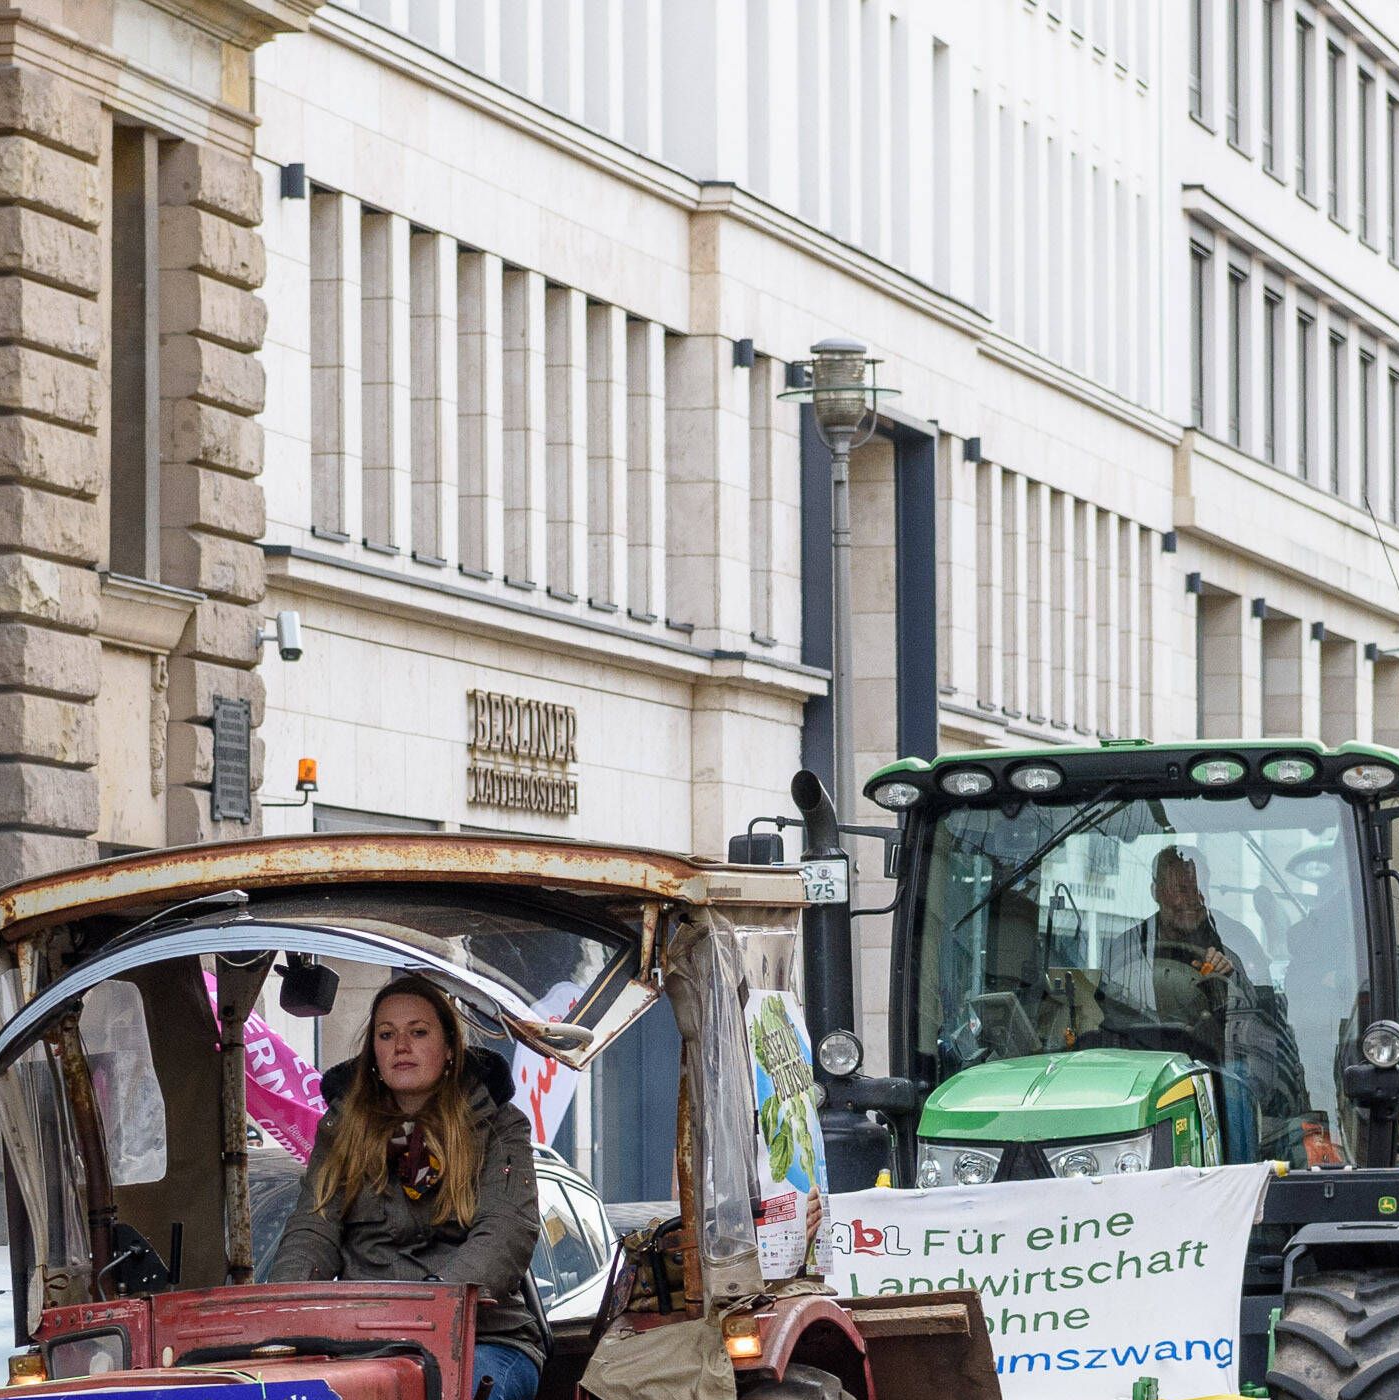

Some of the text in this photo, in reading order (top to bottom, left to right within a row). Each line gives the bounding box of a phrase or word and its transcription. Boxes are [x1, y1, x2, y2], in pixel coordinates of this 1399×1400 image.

[467, 688, 578, 763] BERLINER
[923, 1228, 1006, 1257] Für
[1026, 1211, 1134, 1252] eine
[849, 1239, 1209, 1298] Landwirtschaft
